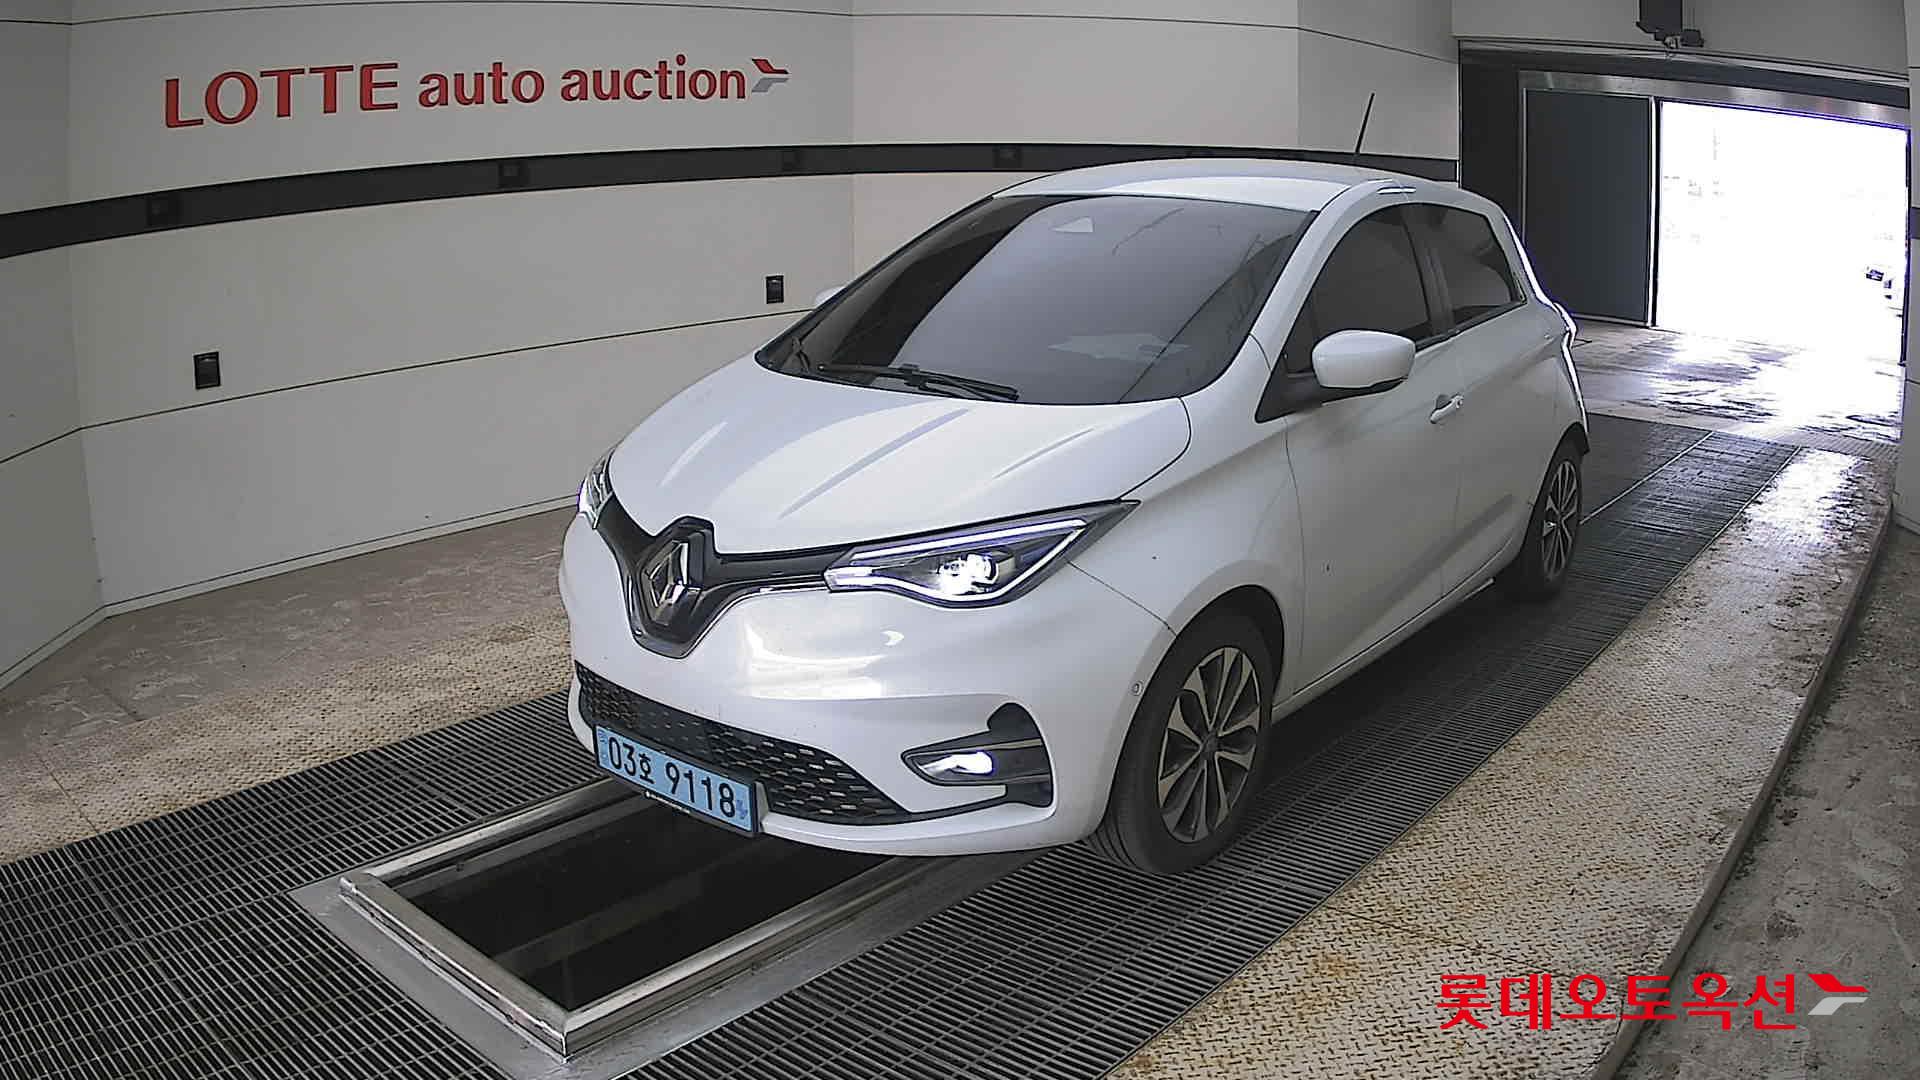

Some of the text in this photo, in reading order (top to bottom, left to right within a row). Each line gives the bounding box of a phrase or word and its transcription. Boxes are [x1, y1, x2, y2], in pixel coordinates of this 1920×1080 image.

[165, 54, 747, 129] LOTTE auto auction
[608, 736, 655, 785] 03호
[665, 762, 736, 818] 9118
